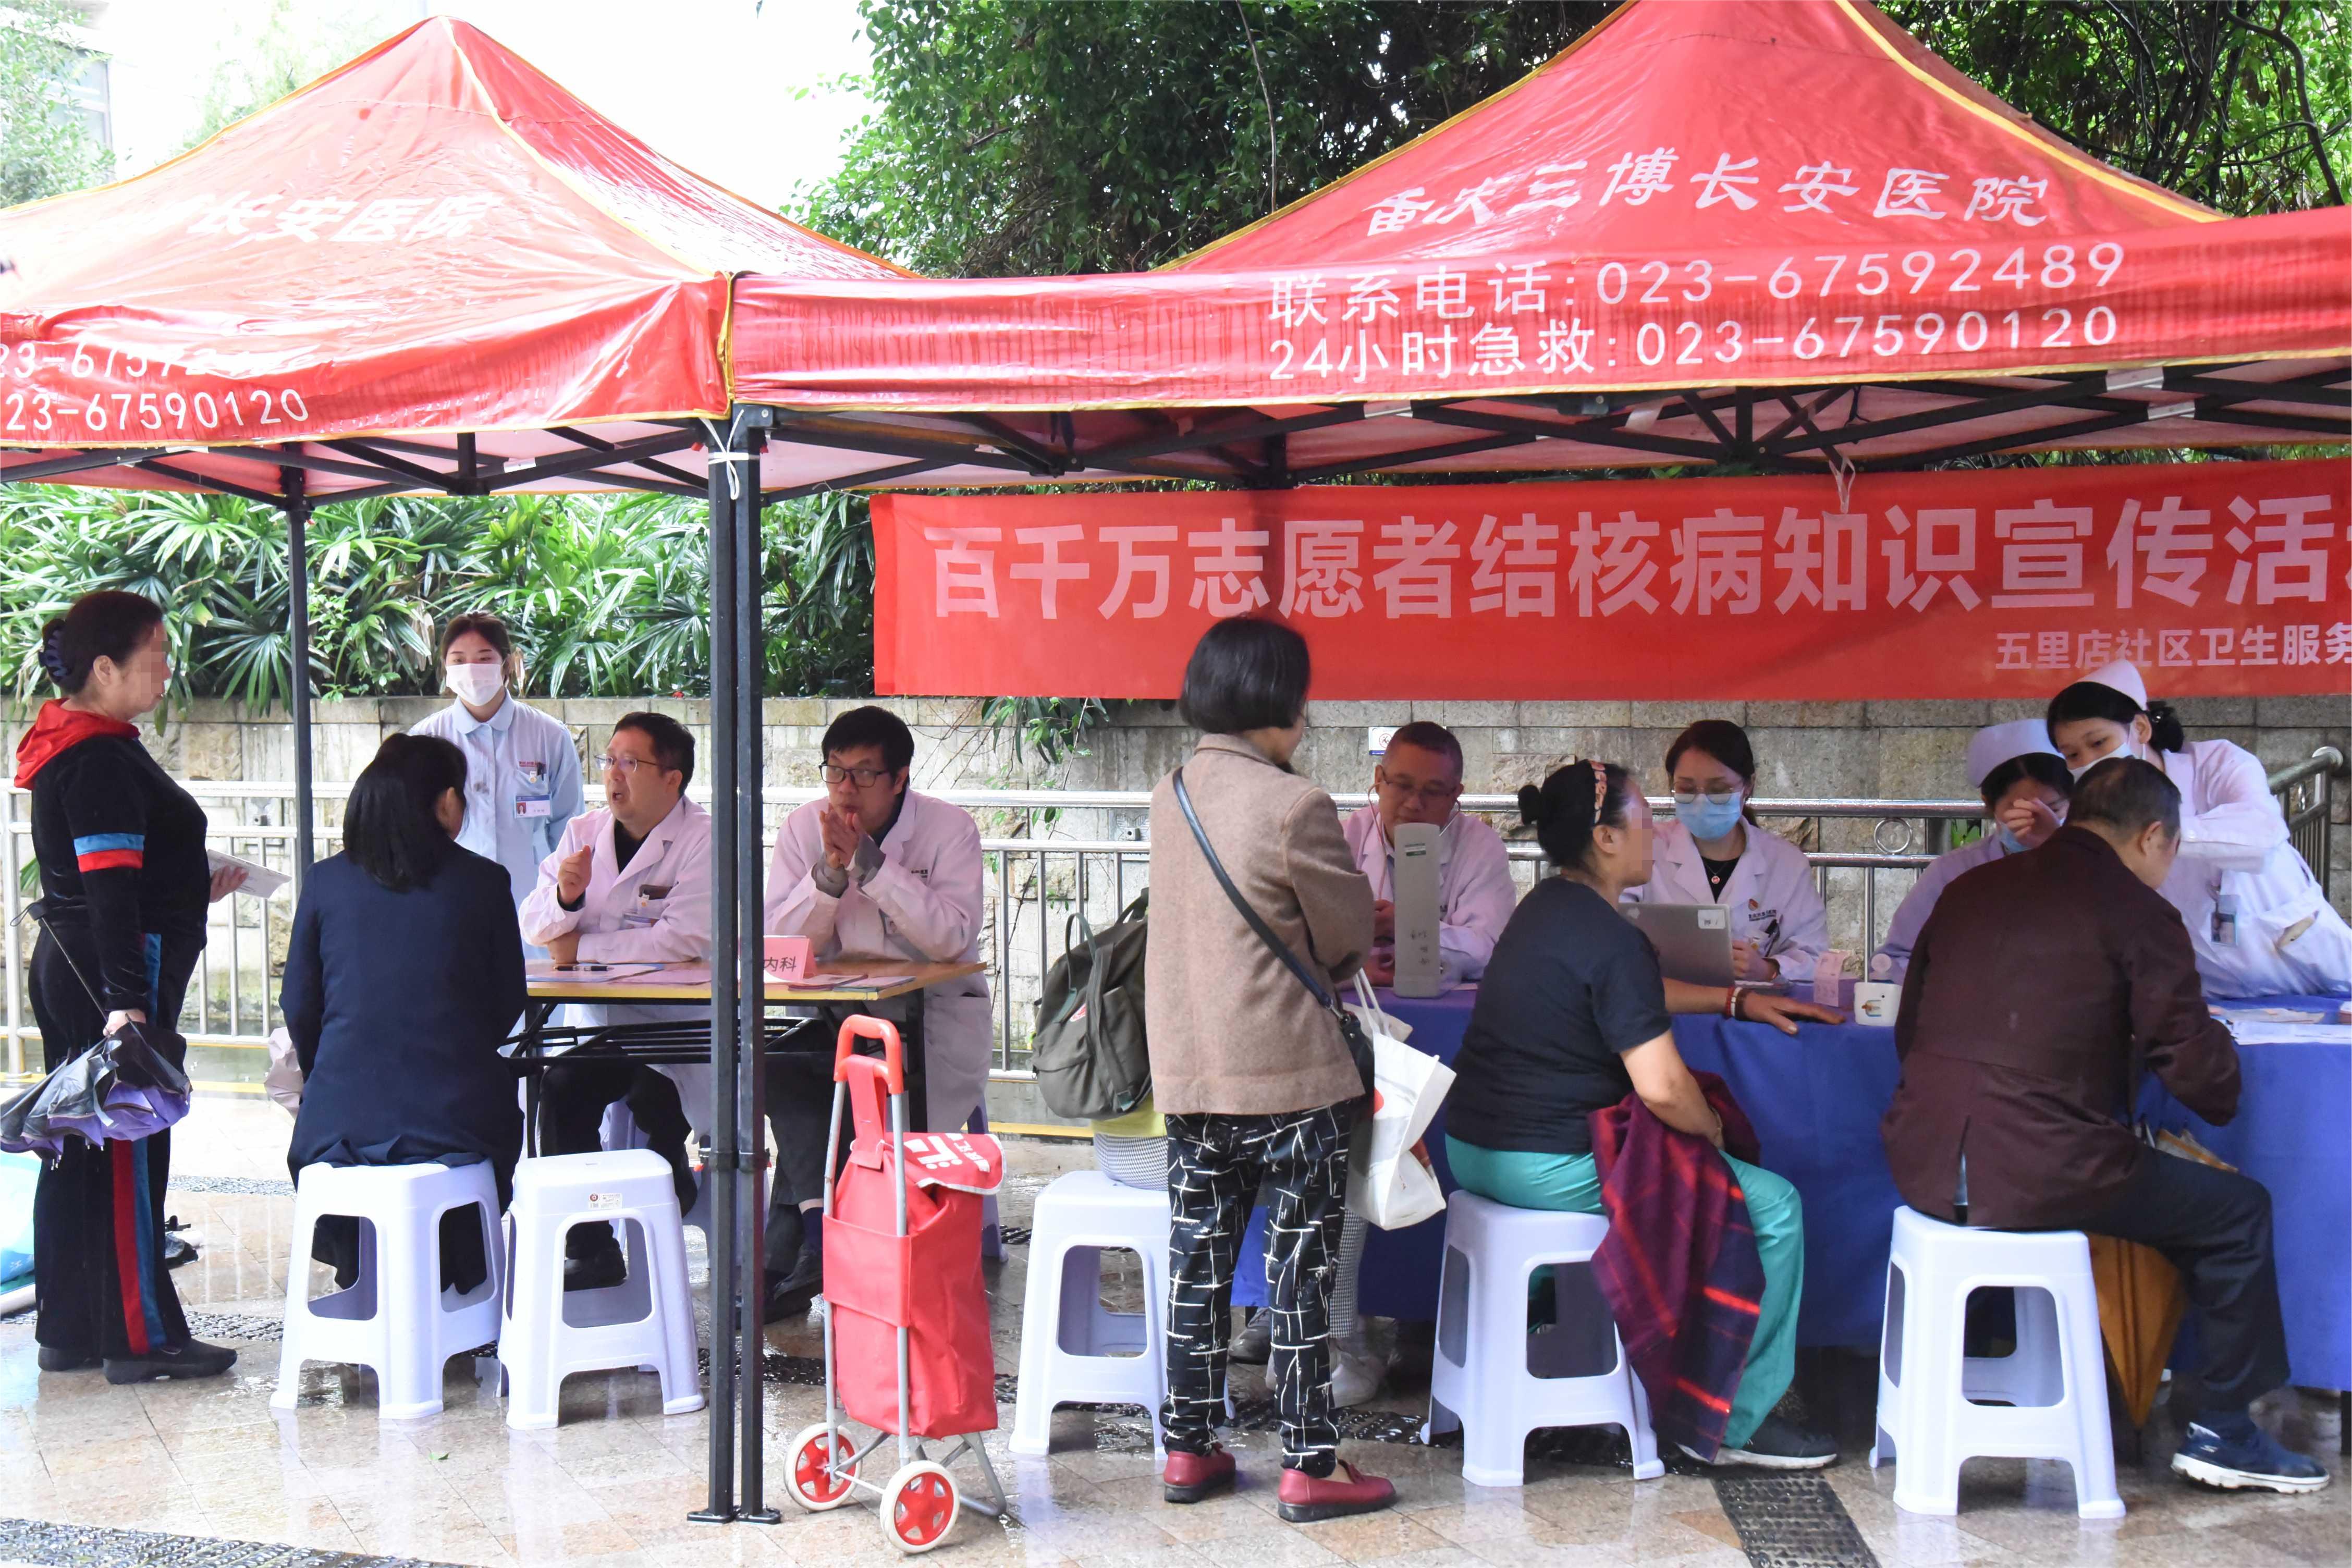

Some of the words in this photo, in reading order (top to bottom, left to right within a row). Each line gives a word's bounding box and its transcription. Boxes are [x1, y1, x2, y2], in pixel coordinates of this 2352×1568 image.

[923, 494, 2351, 620] 百千万志愿者结核病知识宣传活
[1995, 622, 2351, 669] 五里店社区卫生服务
[764, 956, 797, 972] 内科
